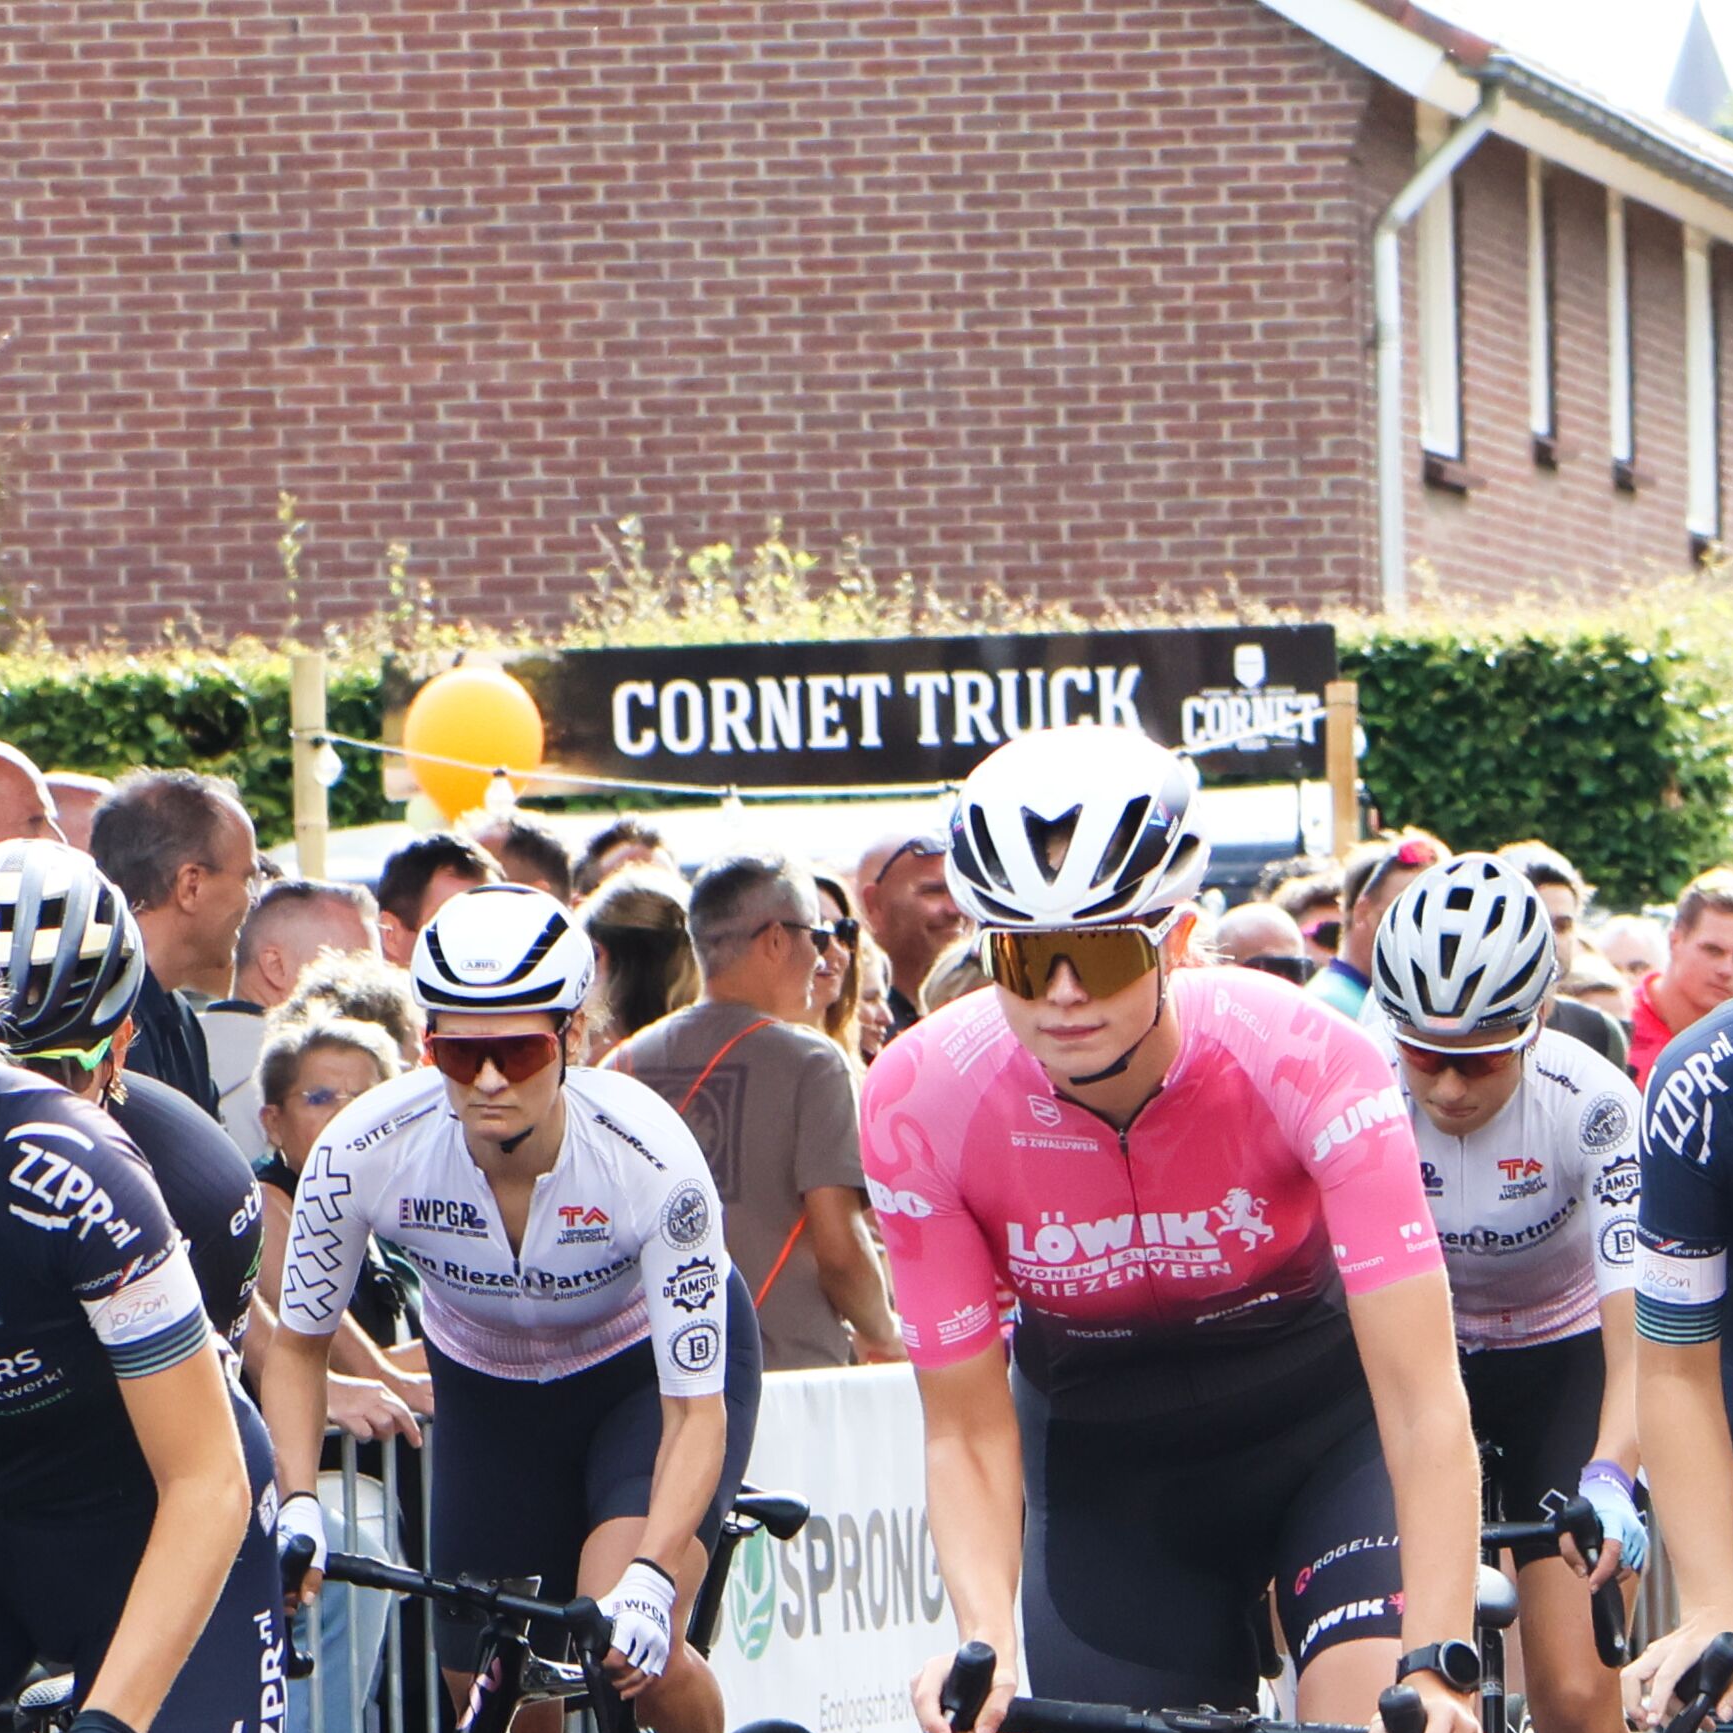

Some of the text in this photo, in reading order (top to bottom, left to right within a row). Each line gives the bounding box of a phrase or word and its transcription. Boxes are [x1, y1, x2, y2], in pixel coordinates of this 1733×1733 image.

[611, 665, 1142, 757] CORNET TRUCK
[1180, 692, 1323, 748] CORNET
[464, 960, 497, 970] ABUS
[353, 1120, 394, 1152] SITE
[8, 1140, 142, 1251] ZZPR.nl
[1604, 1172, 1642, 1193] AMST
[1006, 1210, 1219, 1264] LÖWIK
[1121, 1246, 1205, 1262] SLAPEN
[444, 1260, 532, 1289] Riezen
[1012, 1261, 1233, 1298] VRIEZENVEEN
[1016, 1264, 1093, 1279] WONEN
[778, 1505, 944, 1640] SPRONG
[1312, 1535, 1402, 1574] ROGELLI
[1300, 1596, 1386, 1656] LÖWIK
